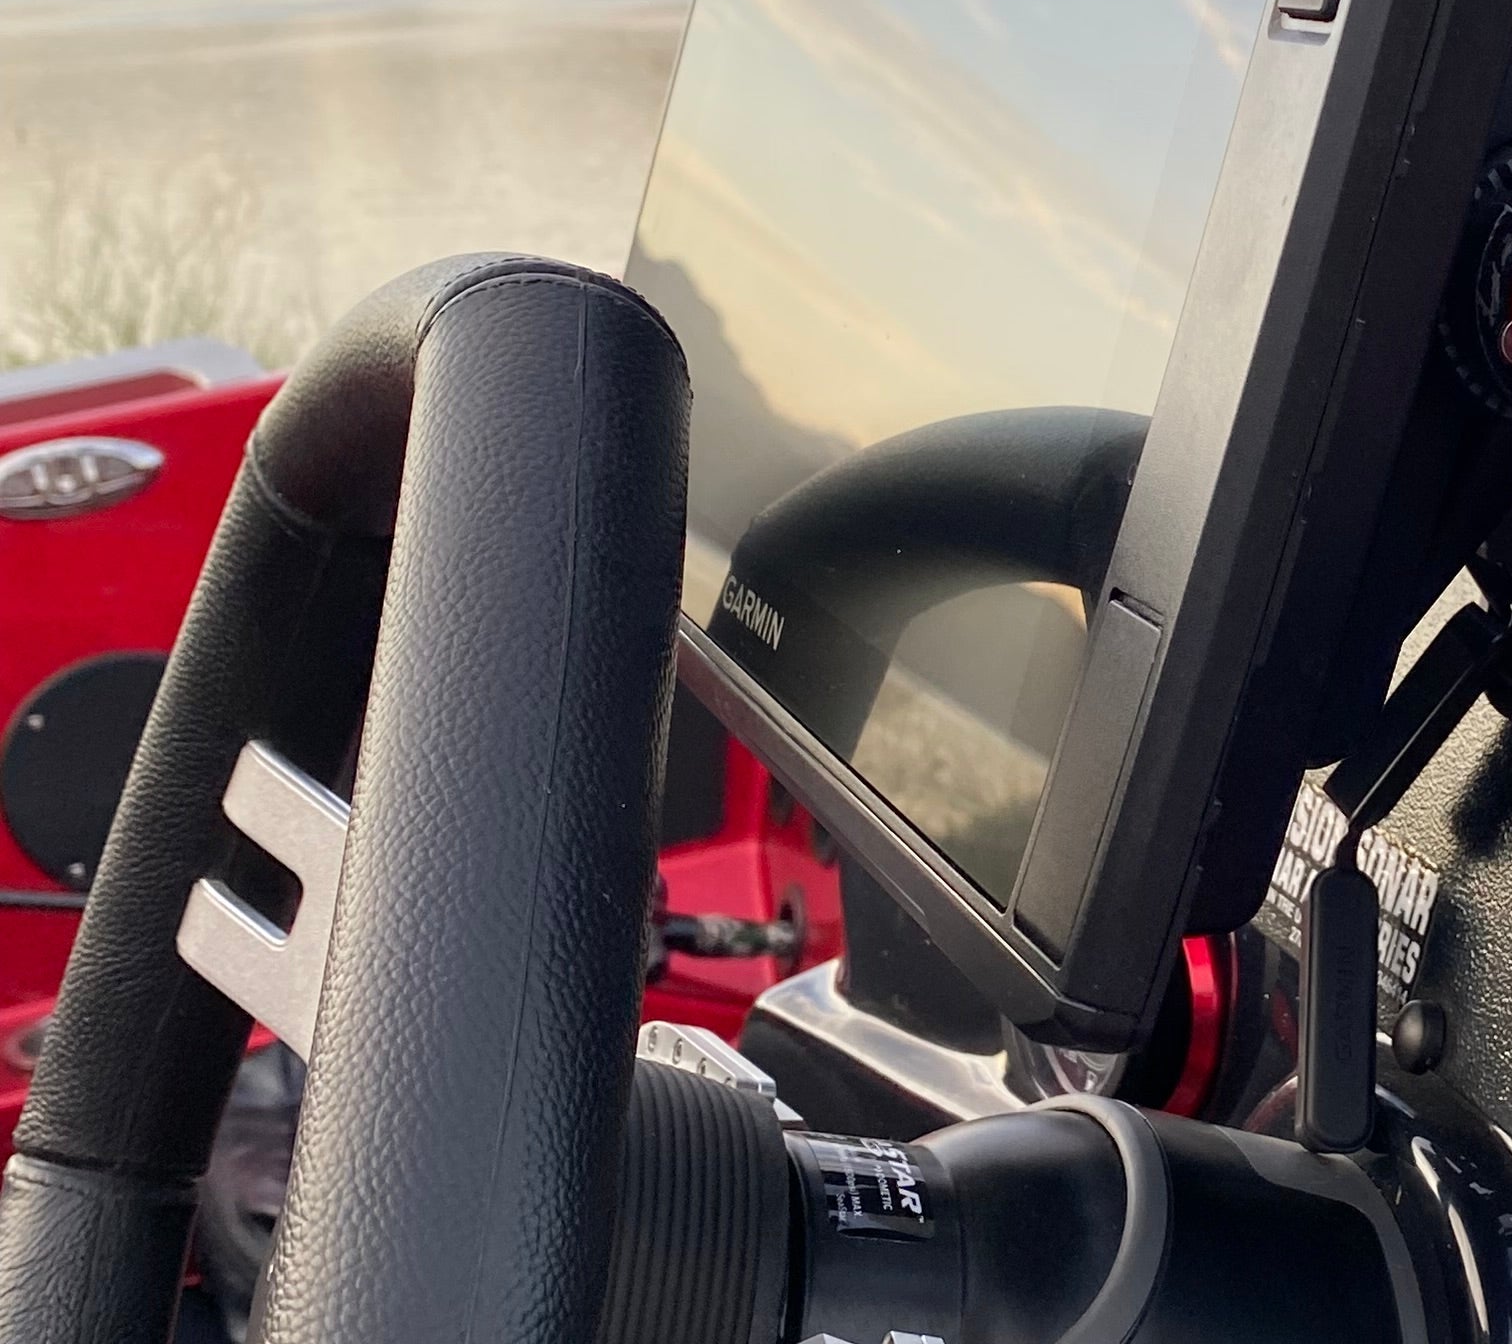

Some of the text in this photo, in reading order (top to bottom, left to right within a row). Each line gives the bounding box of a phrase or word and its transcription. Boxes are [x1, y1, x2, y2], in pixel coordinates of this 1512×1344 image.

[722, 574, 785, 651] GARMIN
[1289, 782, 1440, 937] SION SONAR
[1378, 918, 1421, 985] RIES
[875, 1171, 894, 1212] DOMETIC
